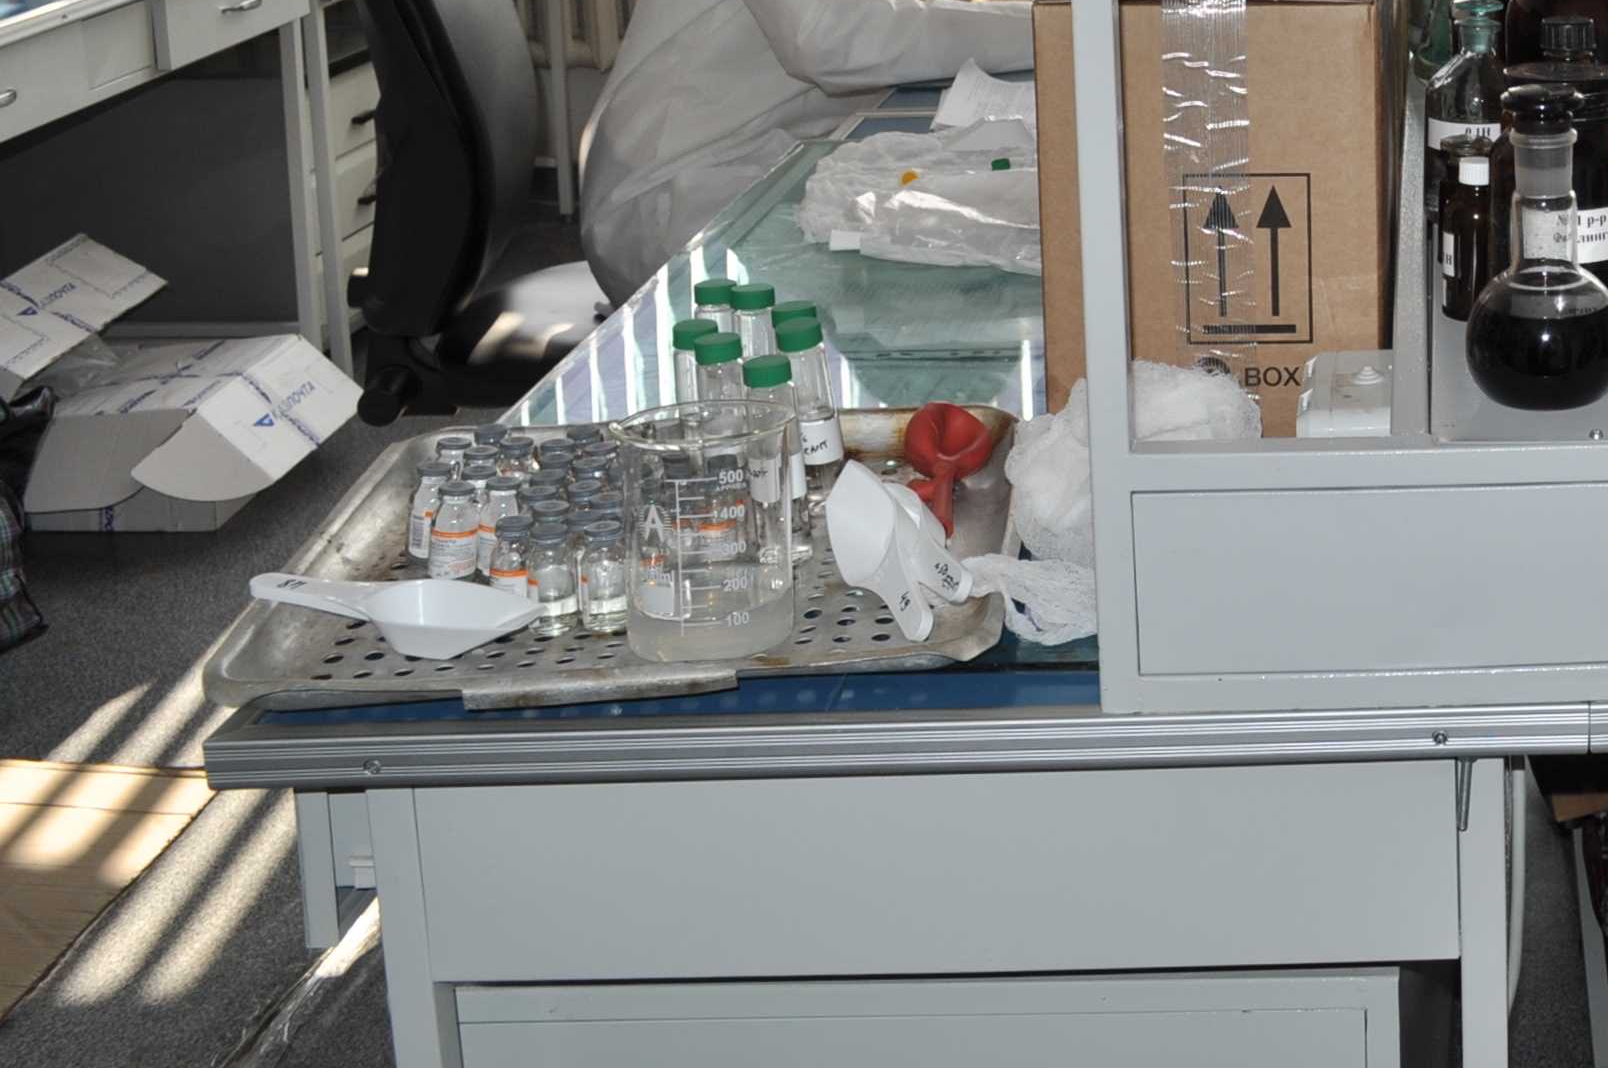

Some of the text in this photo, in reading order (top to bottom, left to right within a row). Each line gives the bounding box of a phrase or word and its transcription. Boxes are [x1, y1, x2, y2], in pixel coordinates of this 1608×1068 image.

[1239, 366, 1301, 387] BOX
[718, 469, 744, 484] 500
[720, 505, 745, 519] 400
[722, 541, 747, 556] 300
[722, 576, 748, 592] 200
[726, 612, 749, 627] 100
